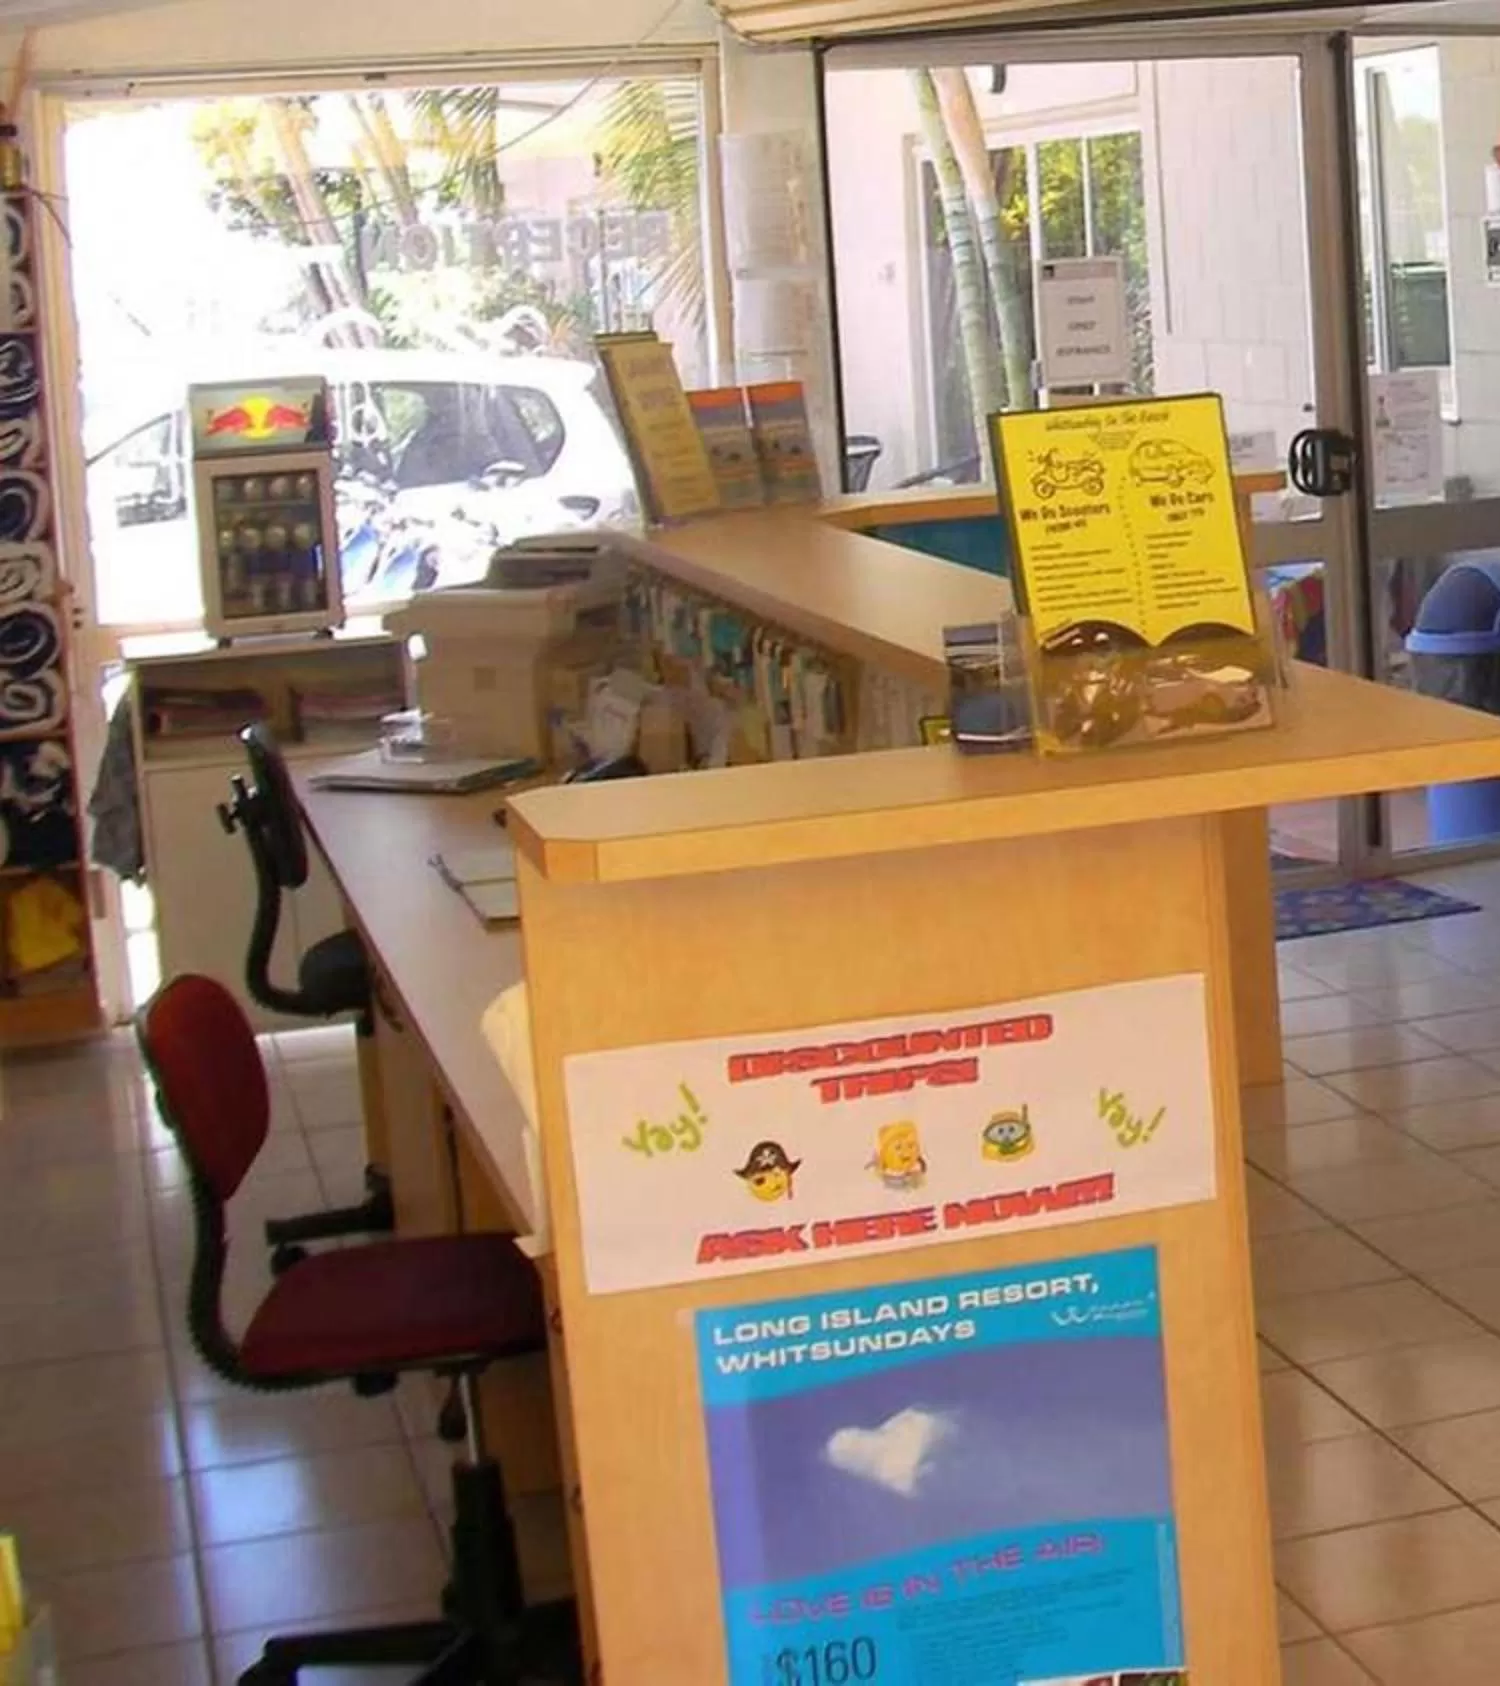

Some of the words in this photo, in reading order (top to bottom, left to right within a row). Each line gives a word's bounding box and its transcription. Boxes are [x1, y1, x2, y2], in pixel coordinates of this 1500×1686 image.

[728, 1013, 1054, 1083] DISCOUNTED
[698, 1222, 808, 1265] ASK
[812, 1206, 939, 1249] HERE
[713, 1310, 812, 1346] LONG
[820, 1294, 950, 1333] ISLAND
[958, 1272, 1100, 1312] RESORT,
[716, 1320, 977, 1375] WHITSUNDAYS
[748, 1592, 852, 1626] LOVE
[952, 1544, 1025, 1582] THE
[776, 1635, 877, 1686] $160
